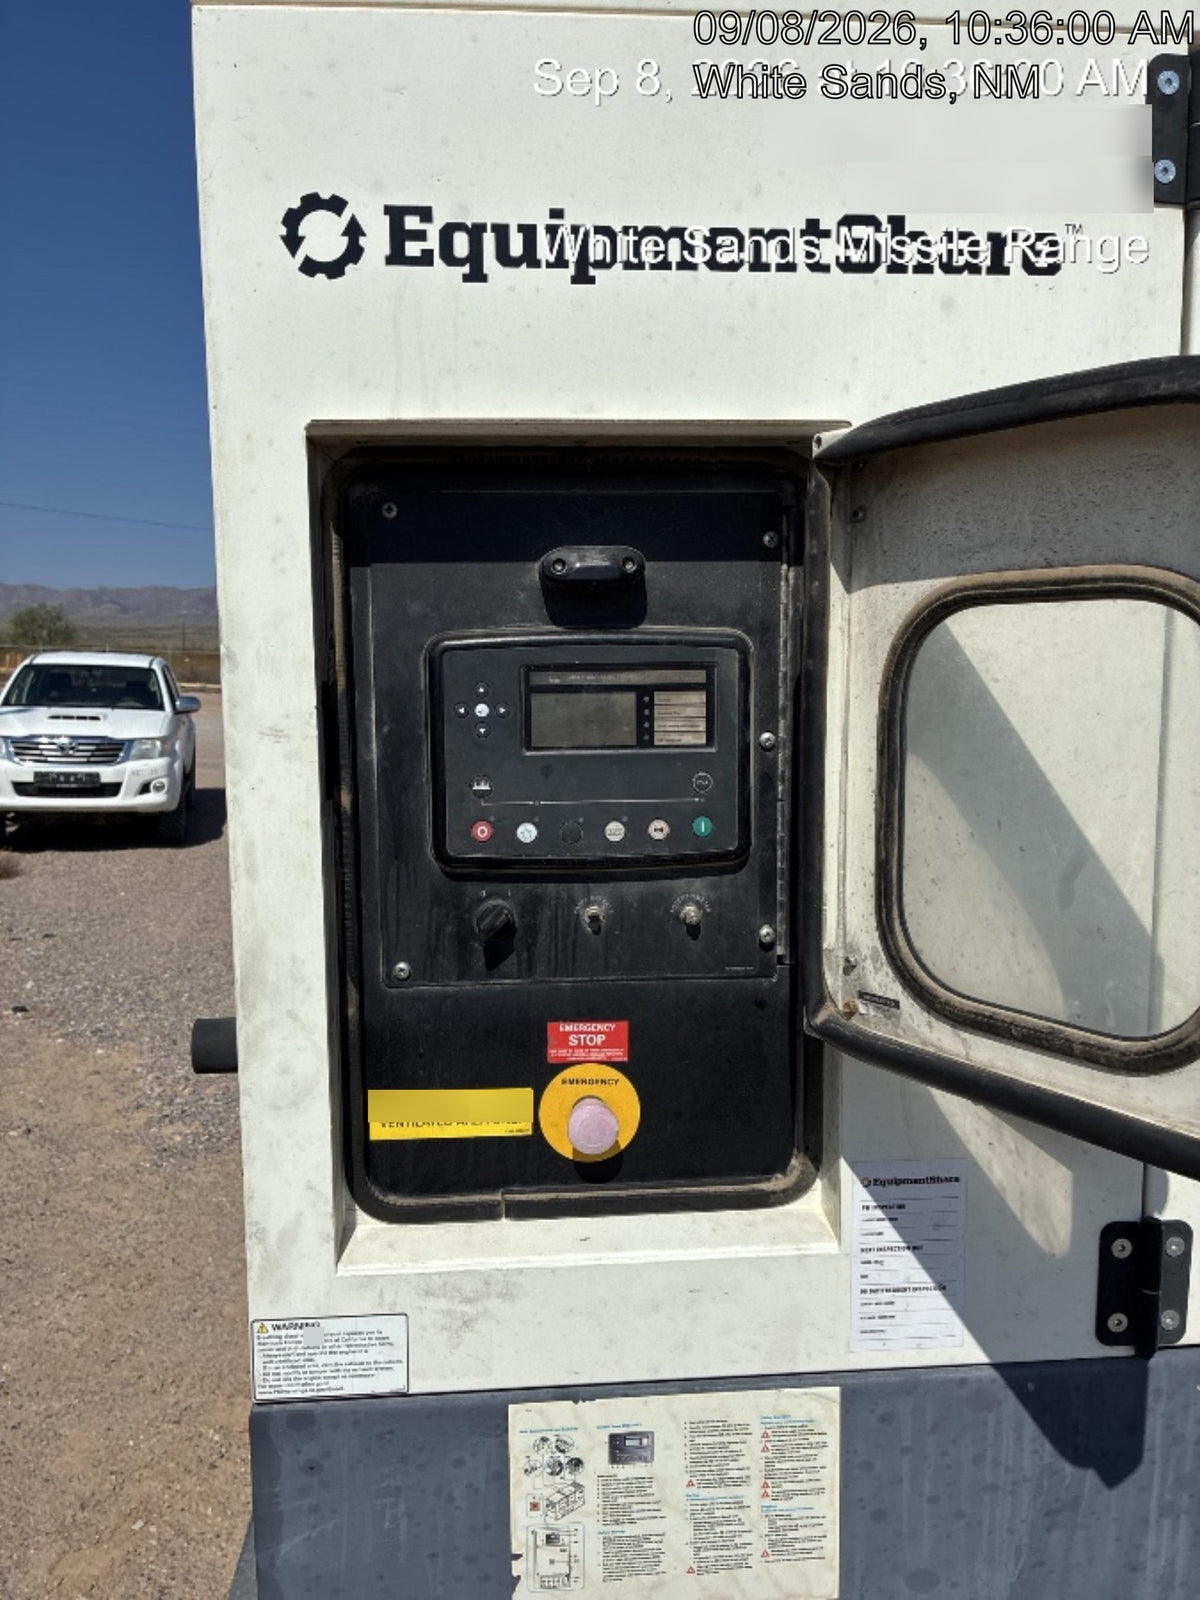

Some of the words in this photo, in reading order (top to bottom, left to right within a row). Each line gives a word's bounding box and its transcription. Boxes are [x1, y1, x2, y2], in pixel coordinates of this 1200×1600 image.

[559, 1023, 616, 1032] EMERGENCY
[568, 1033, 606, 1047] STOP
[560, 1077, 621, 1087] EMERGENCY
[872, 1176, 960, 1188] EquipmentShare
